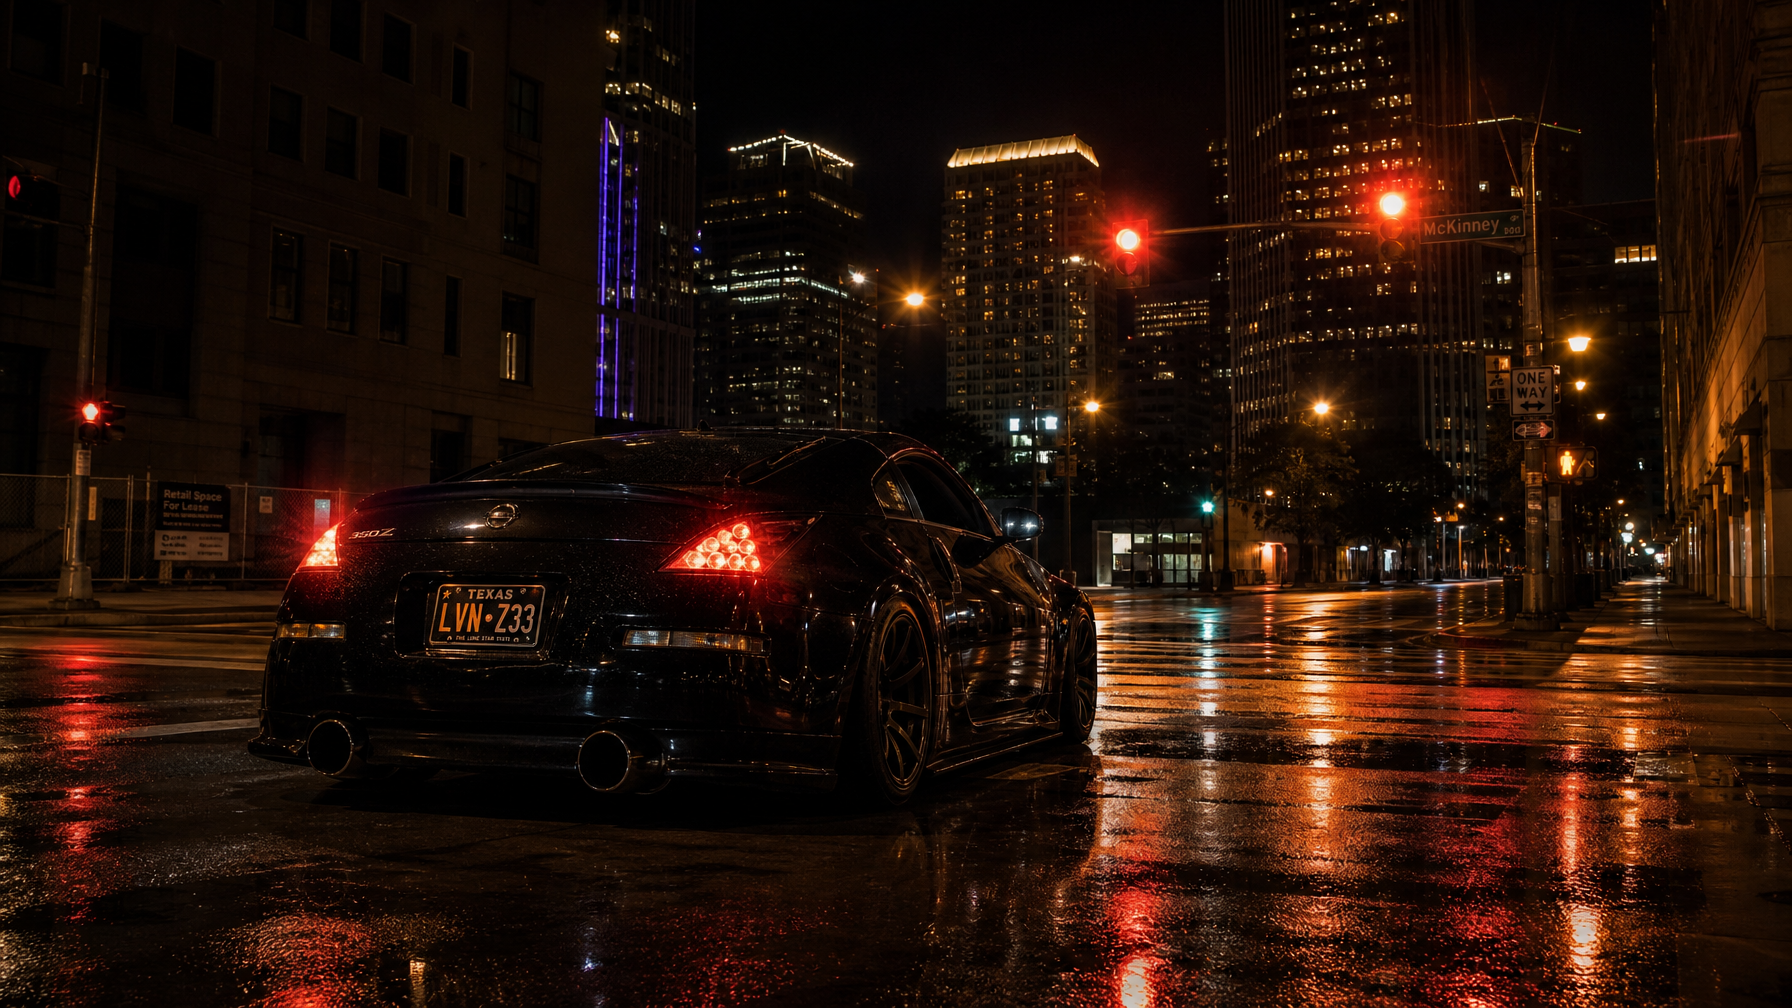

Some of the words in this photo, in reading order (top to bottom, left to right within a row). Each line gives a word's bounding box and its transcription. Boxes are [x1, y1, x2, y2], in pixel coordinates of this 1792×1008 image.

[1424, 218, 1499, 236] McKinney
[1517, 371, 1546, 385] ONE
[1517, 386, 1547, 398] WAY
[164, 489, 191, 500] Retail
[194, 491, 222, 502] Space
[163, 500, 180, 510] For
[181, 501, 209, 512] Lease
[348, 528, 396, 539] 350Z
[468, 589, 513, 599] TEXAS
